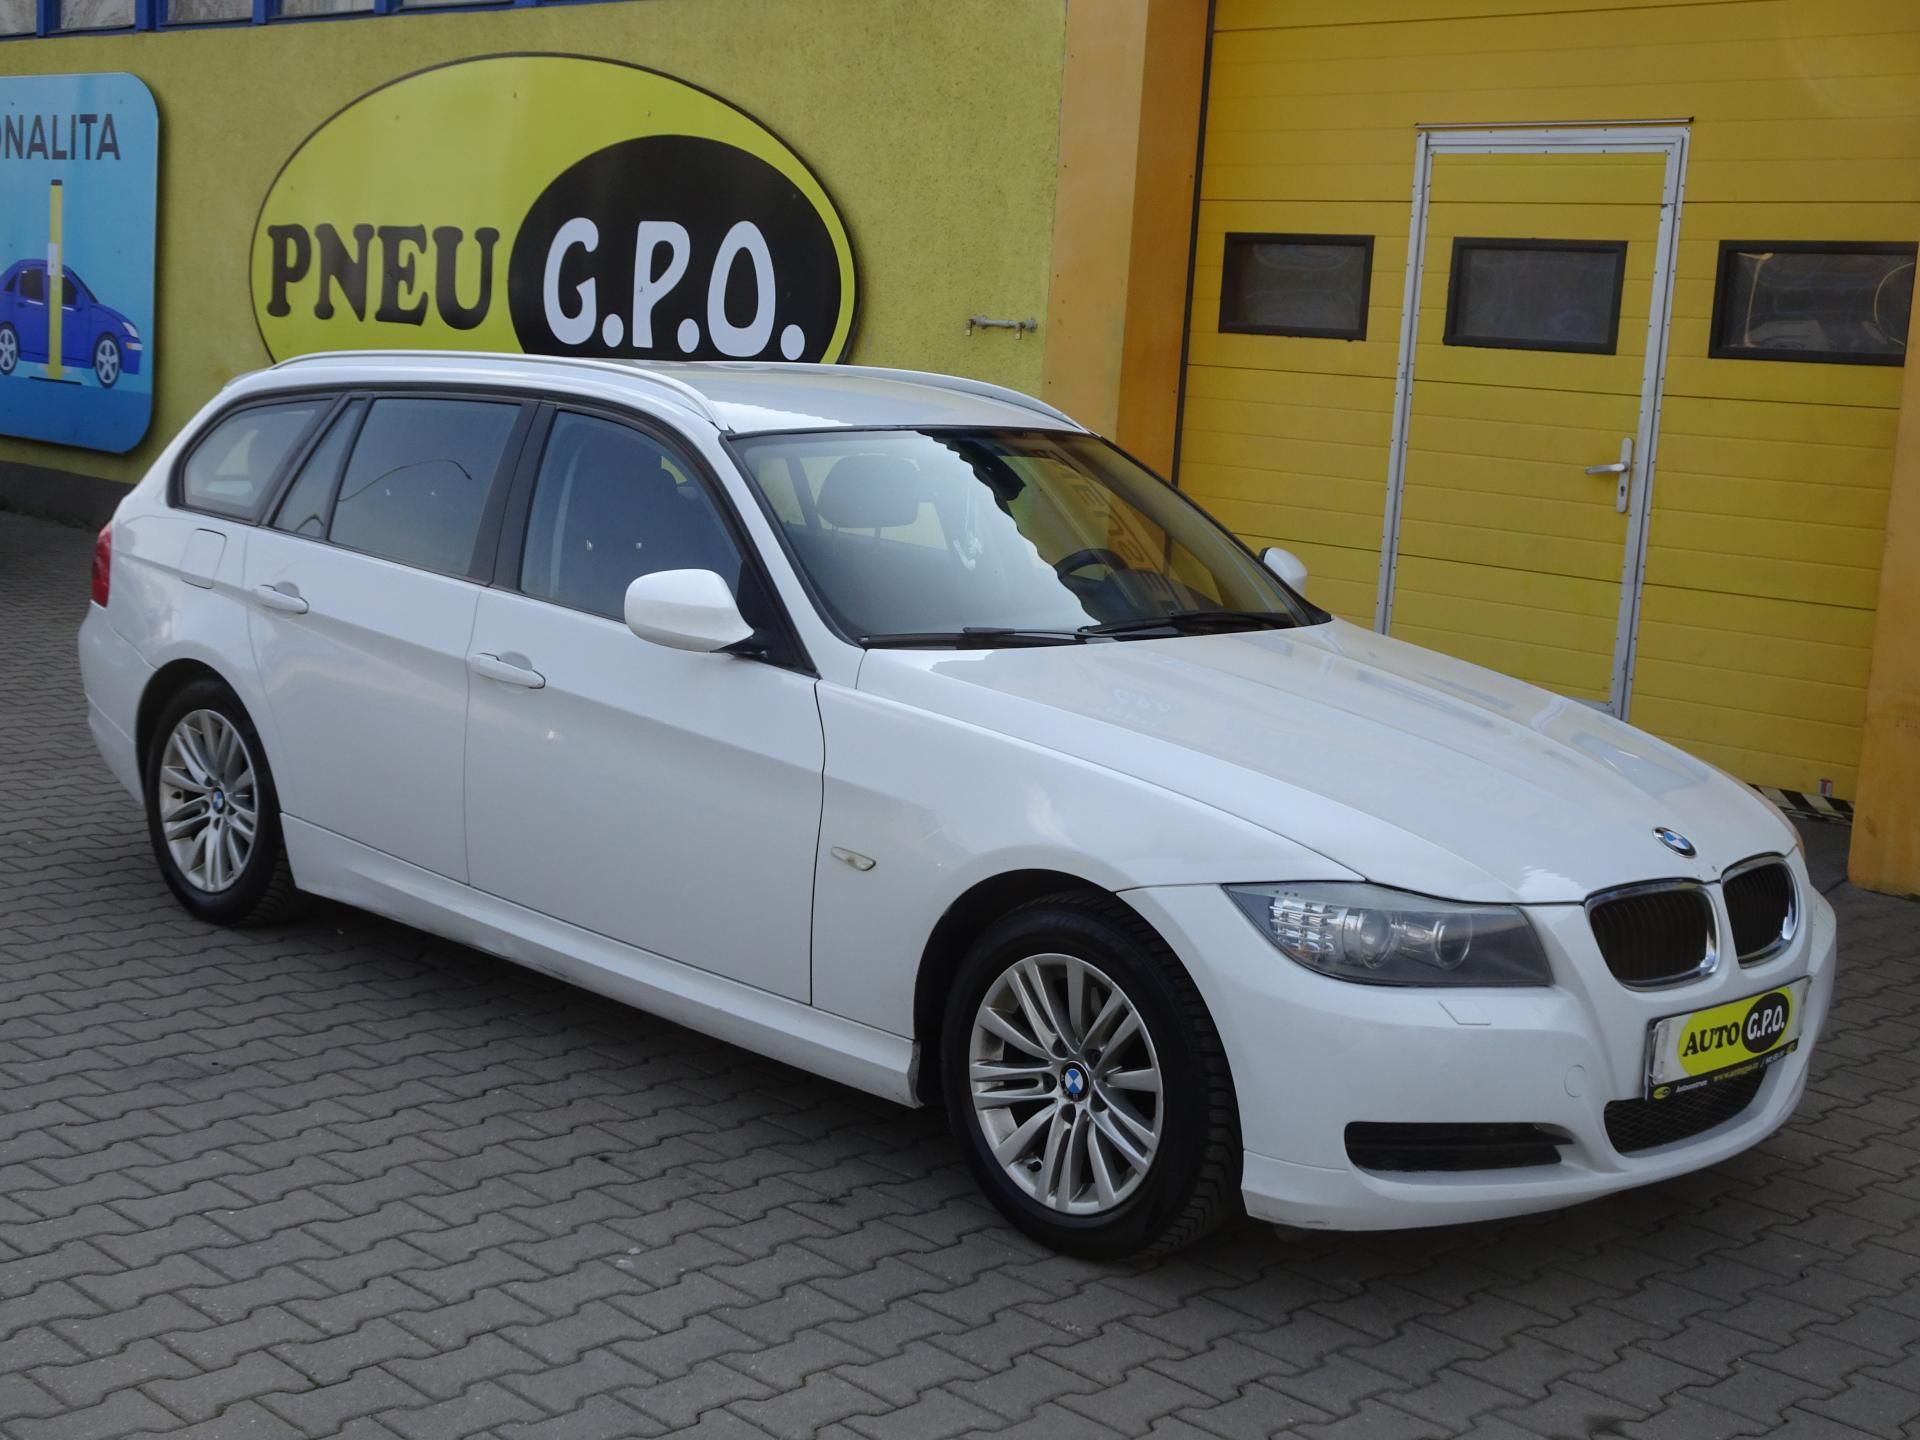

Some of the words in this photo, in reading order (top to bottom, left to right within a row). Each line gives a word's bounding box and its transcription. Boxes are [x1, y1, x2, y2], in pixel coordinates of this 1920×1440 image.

[0, 113, 121, 161] NALITA
[266, 223, 500, 330] PNEU
[543, 217, 805, 360] G.P.O.
[1682, 1021, 1740, 1057] AUTO
[1747, 1005, 1785, 1040] G.P.O.
